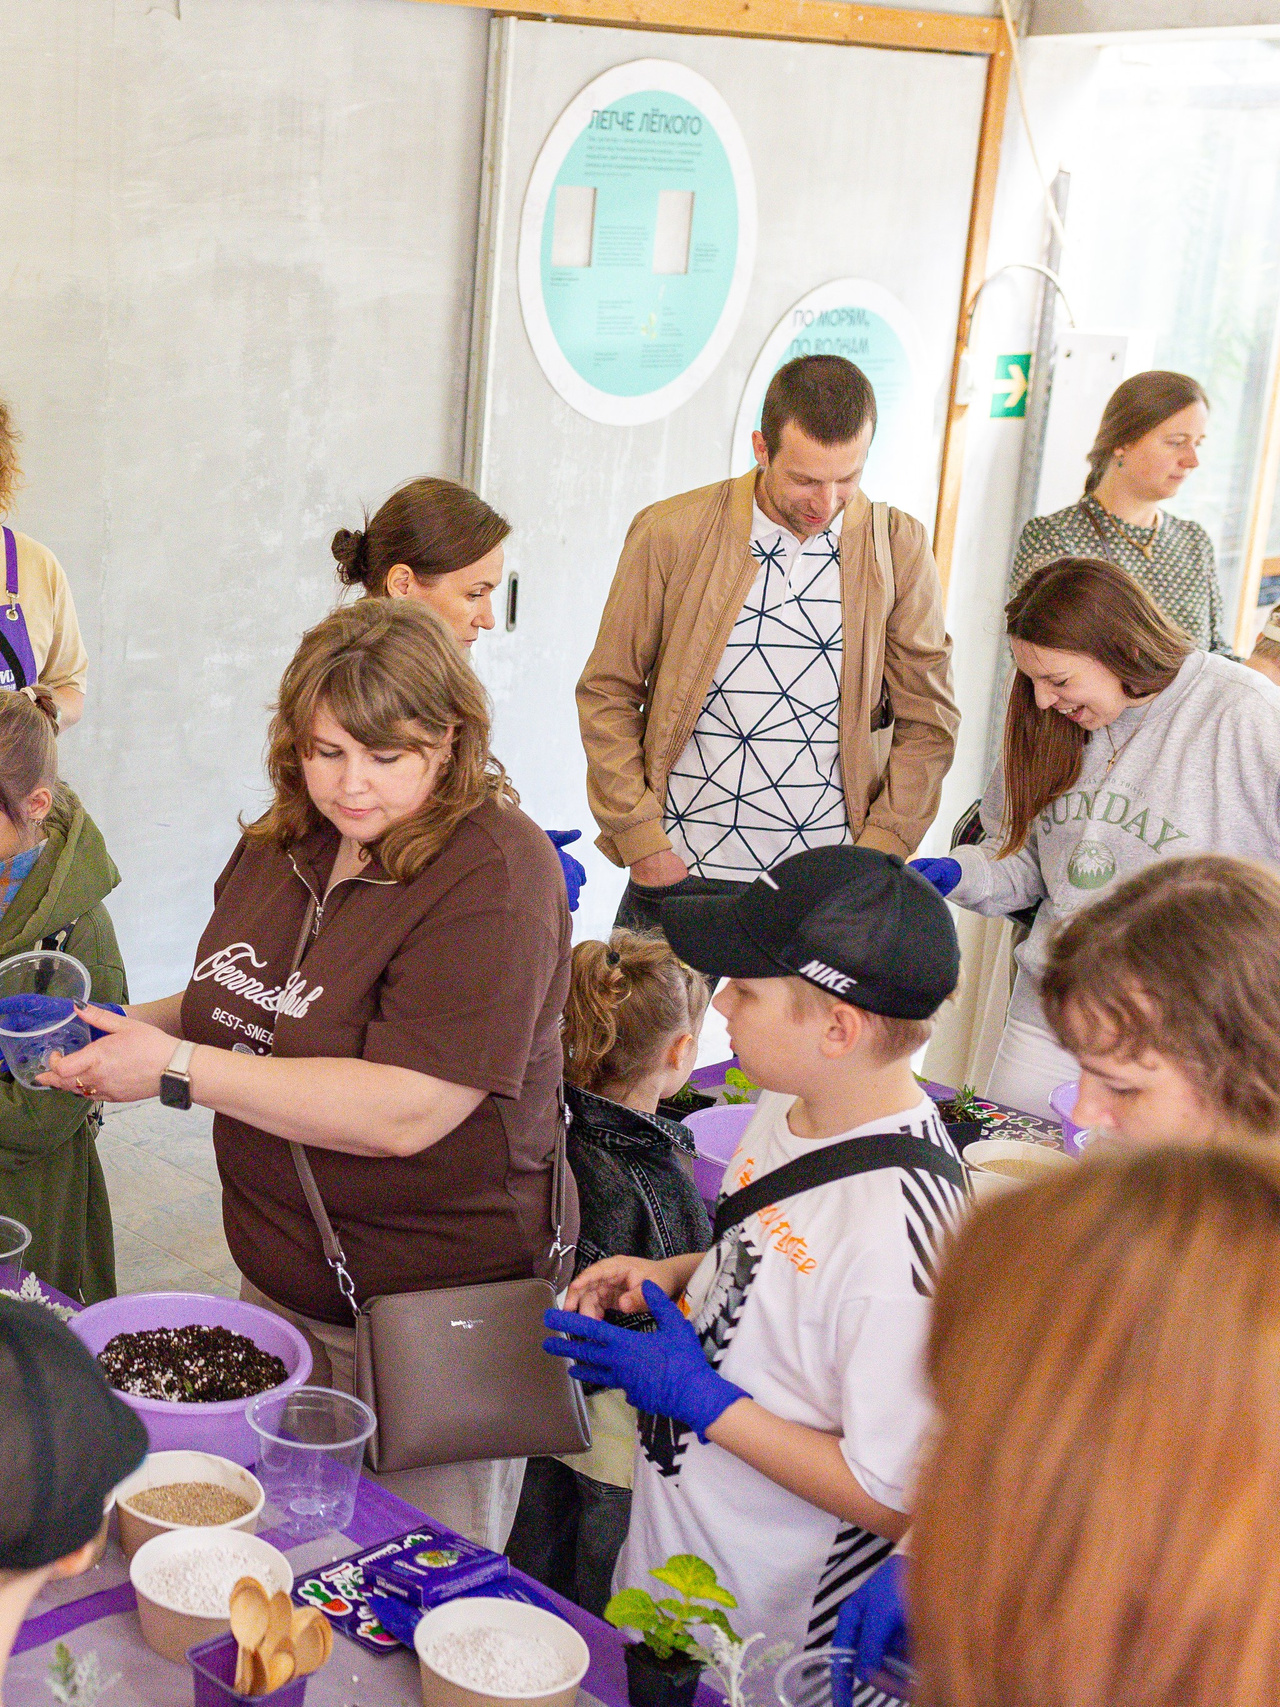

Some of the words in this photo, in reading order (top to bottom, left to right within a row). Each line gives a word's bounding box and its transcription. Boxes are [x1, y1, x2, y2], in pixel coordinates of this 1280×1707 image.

[588, 109, 635, 131] ЛЕГЧЕ
[638, 107, 702, 135] ЛЁГКОГО
[793, 309, 815, 328] ПО
[1039, 789, 1190, 855] SUNDAY
[799, 960, 858, 994] NIKE
